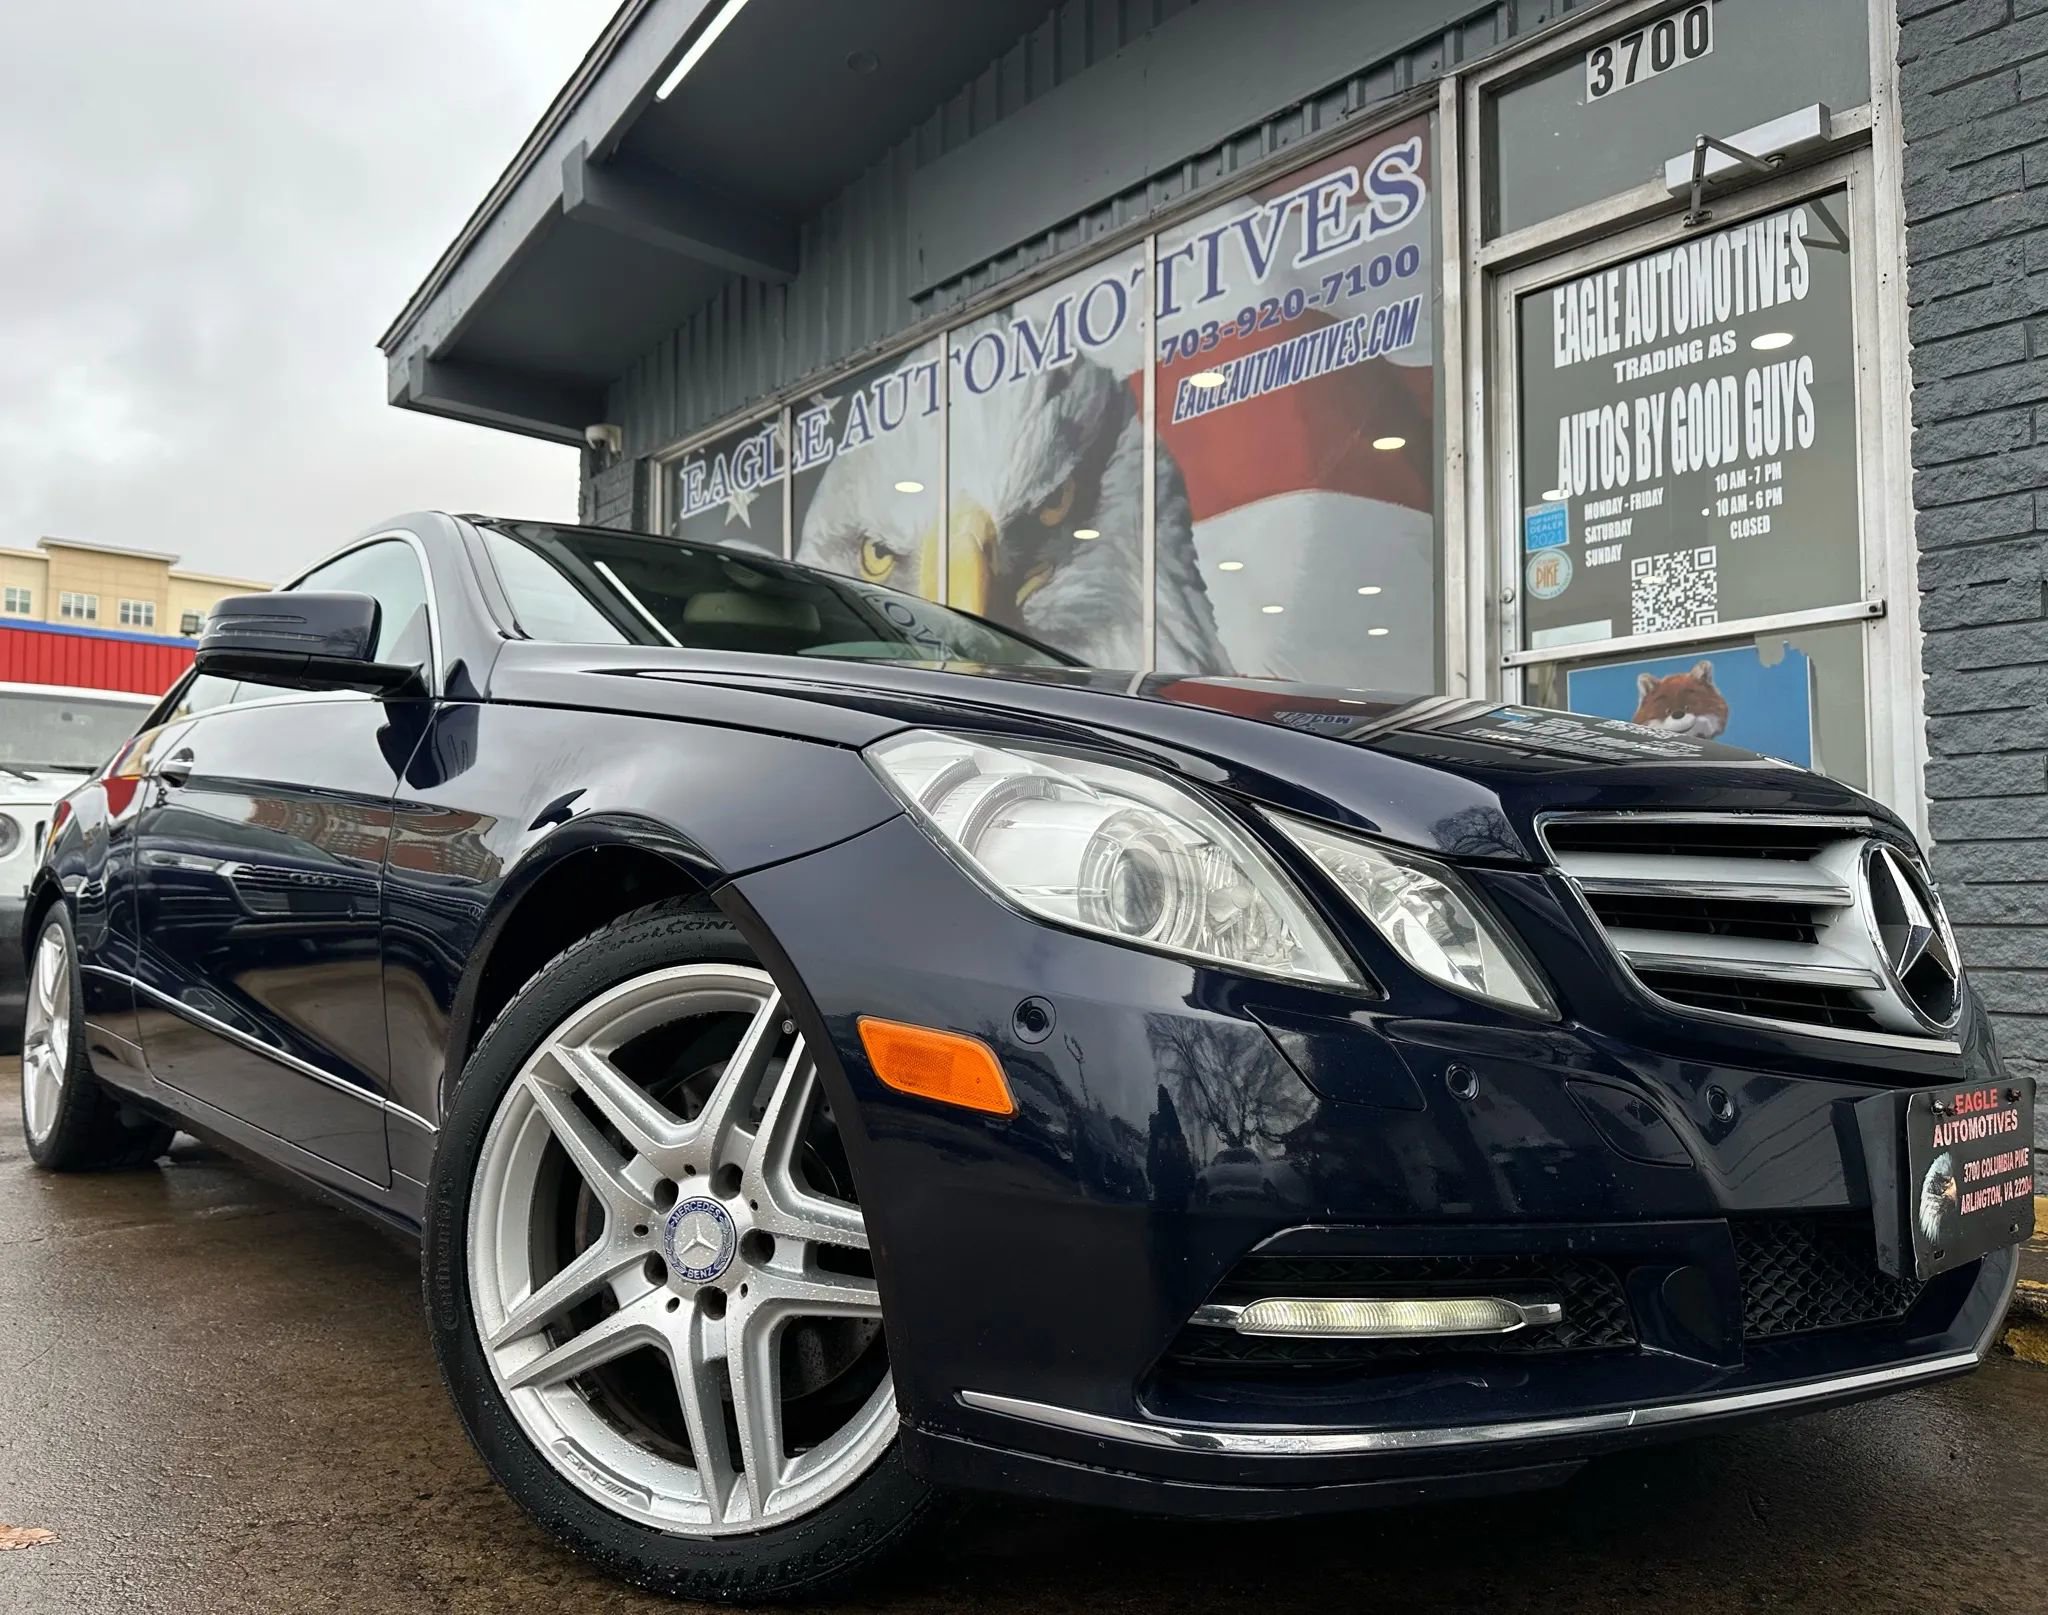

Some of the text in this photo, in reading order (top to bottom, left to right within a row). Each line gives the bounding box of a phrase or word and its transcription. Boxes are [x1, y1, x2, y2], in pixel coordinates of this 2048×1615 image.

[1589, 5, 1710, 98] 3700
[1553, 208, 1810, 368] EAGLE AUTOMOTIVES
[1161, 244, 1421, 367] 703-920-7100
[681, 136, 1426, 519] EAGLE AUTOMOTIVES
[1173, 295, 1422, 423] EAGLEAUTOMOTIVES.COM
[1613, 329, 1737, 384] TRADING AS
[1558, 355, 1815, 497] AUTOS BY GOOD GUYS
[1715, 473, 1728, 493] 10
[1729, 468, 1747, 490] AM
[1754, 465, 1761, 484] 7
[1764, 461, 1782, 482] PM
[1584, 496, 1623, 521] MONDAY
[1630, 487, 1664, 511] FRIDAY
[1716, 498, 1729, 517] 10
[1730, 493, 1747, 515] AM
[1755, 490, 1763, 509] 6
[1765, 486, 1782, 508] PM
[1585, 517, 1632, 544] SATURDAY
[1730, 515, 1770, 540] CLOSED
[1585, 543, 1622, 567] SUNDAY
[1535, 562, 1560, 589] PIKE
[1955, 1088, 1998, 1115] EAGLE
[1933, 1109, 2018, 1148] AUTOMOTIVES
[1964, 1147, 2029, 1183] 3700 COLUMBIA PIKE
[671, 1201, 721, 1223] MERCEDES
[1961, 1184, 2002, 1215] ARLINGTON,
[2004, 1181, 2013, 1201] VA
[687, 1267, 714, 1279] BENZ
